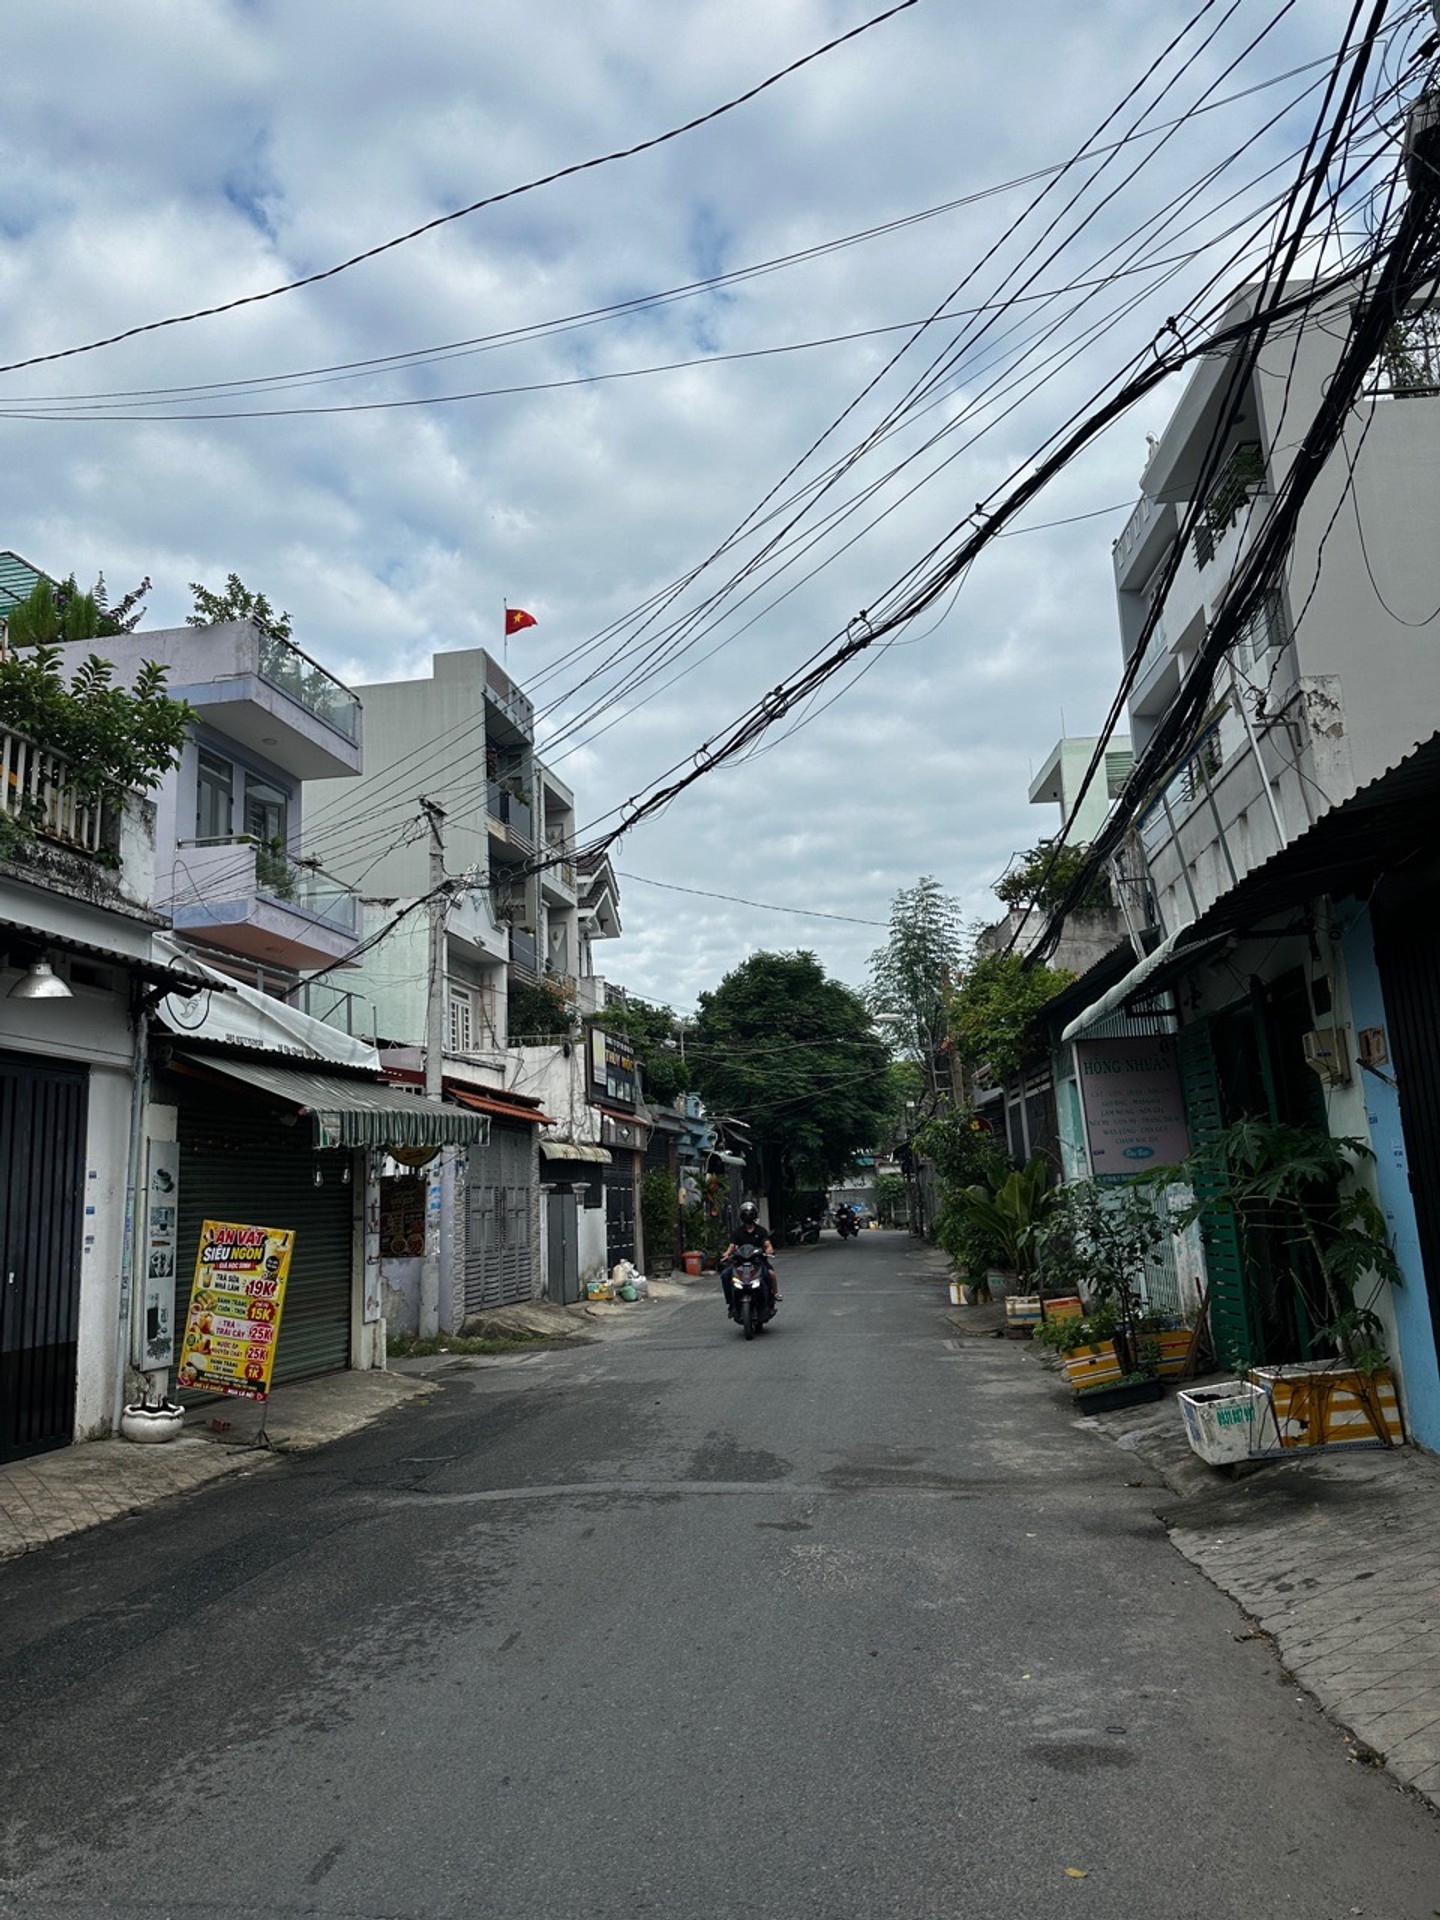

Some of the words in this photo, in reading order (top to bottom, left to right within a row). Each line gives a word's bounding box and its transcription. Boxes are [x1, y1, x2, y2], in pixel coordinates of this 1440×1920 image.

[214, 1226, 236, 1244] ĂN
[236, 1227, 266, 1248] VẬT
[203, 1244, 231, 1261] SIÊU
[230, 1246, 263, 1260] NGON
[248, 1279, 275, 1296] 19K
[251, 1307, 272, 1320] 15K
[251, 1327, 272, 1340] 25K
[248, 1347, 267, 1360] 25K
[248, 1368, 260, 1379] 1K
